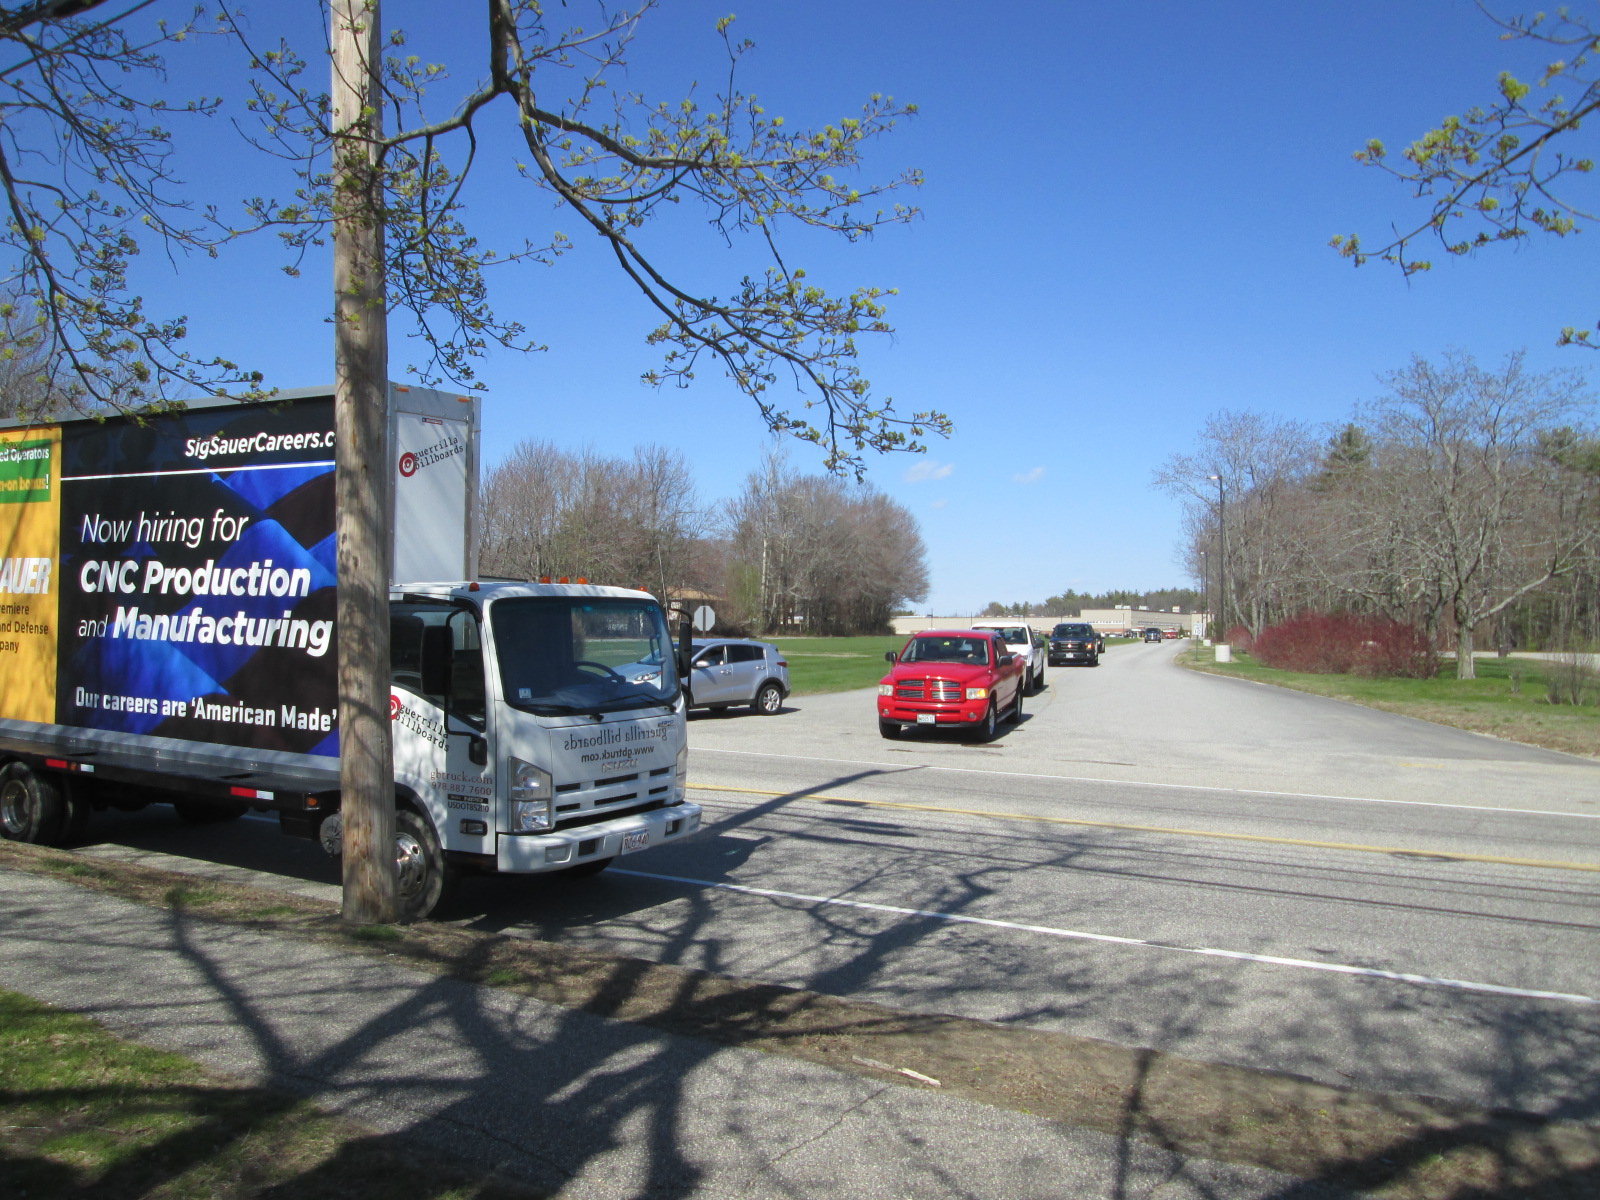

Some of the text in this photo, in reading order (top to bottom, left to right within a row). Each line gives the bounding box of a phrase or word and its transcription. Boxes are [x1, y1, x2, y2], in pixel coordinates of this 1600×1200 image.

[11, 448, 50, 463] Operators
[185, 430, 337, 460] SigSauerCareers.c
[414, 437, 458, 461] guerrilla
[414, 445, 464, 470] billboards
[81, 508, 249, 548] Now hiring for
[0, 557, 52, 594] AUER
[80, 559, 311, 597] CNC Production
[14, 621, 49, 635] Defense
[78, 606, 333, 657] and Manufacturing
[76, 686, 100, 708] Our
[103, 693, 158, 715] careers
[162, 700, 187, 717] are
[396, 710, 450, 752] billboards
[400, 704, 449, 739] guerrilla
[431, 768, 493, 784] gbtruck.com
[432, 781, 492, 796] 978.887.7600
